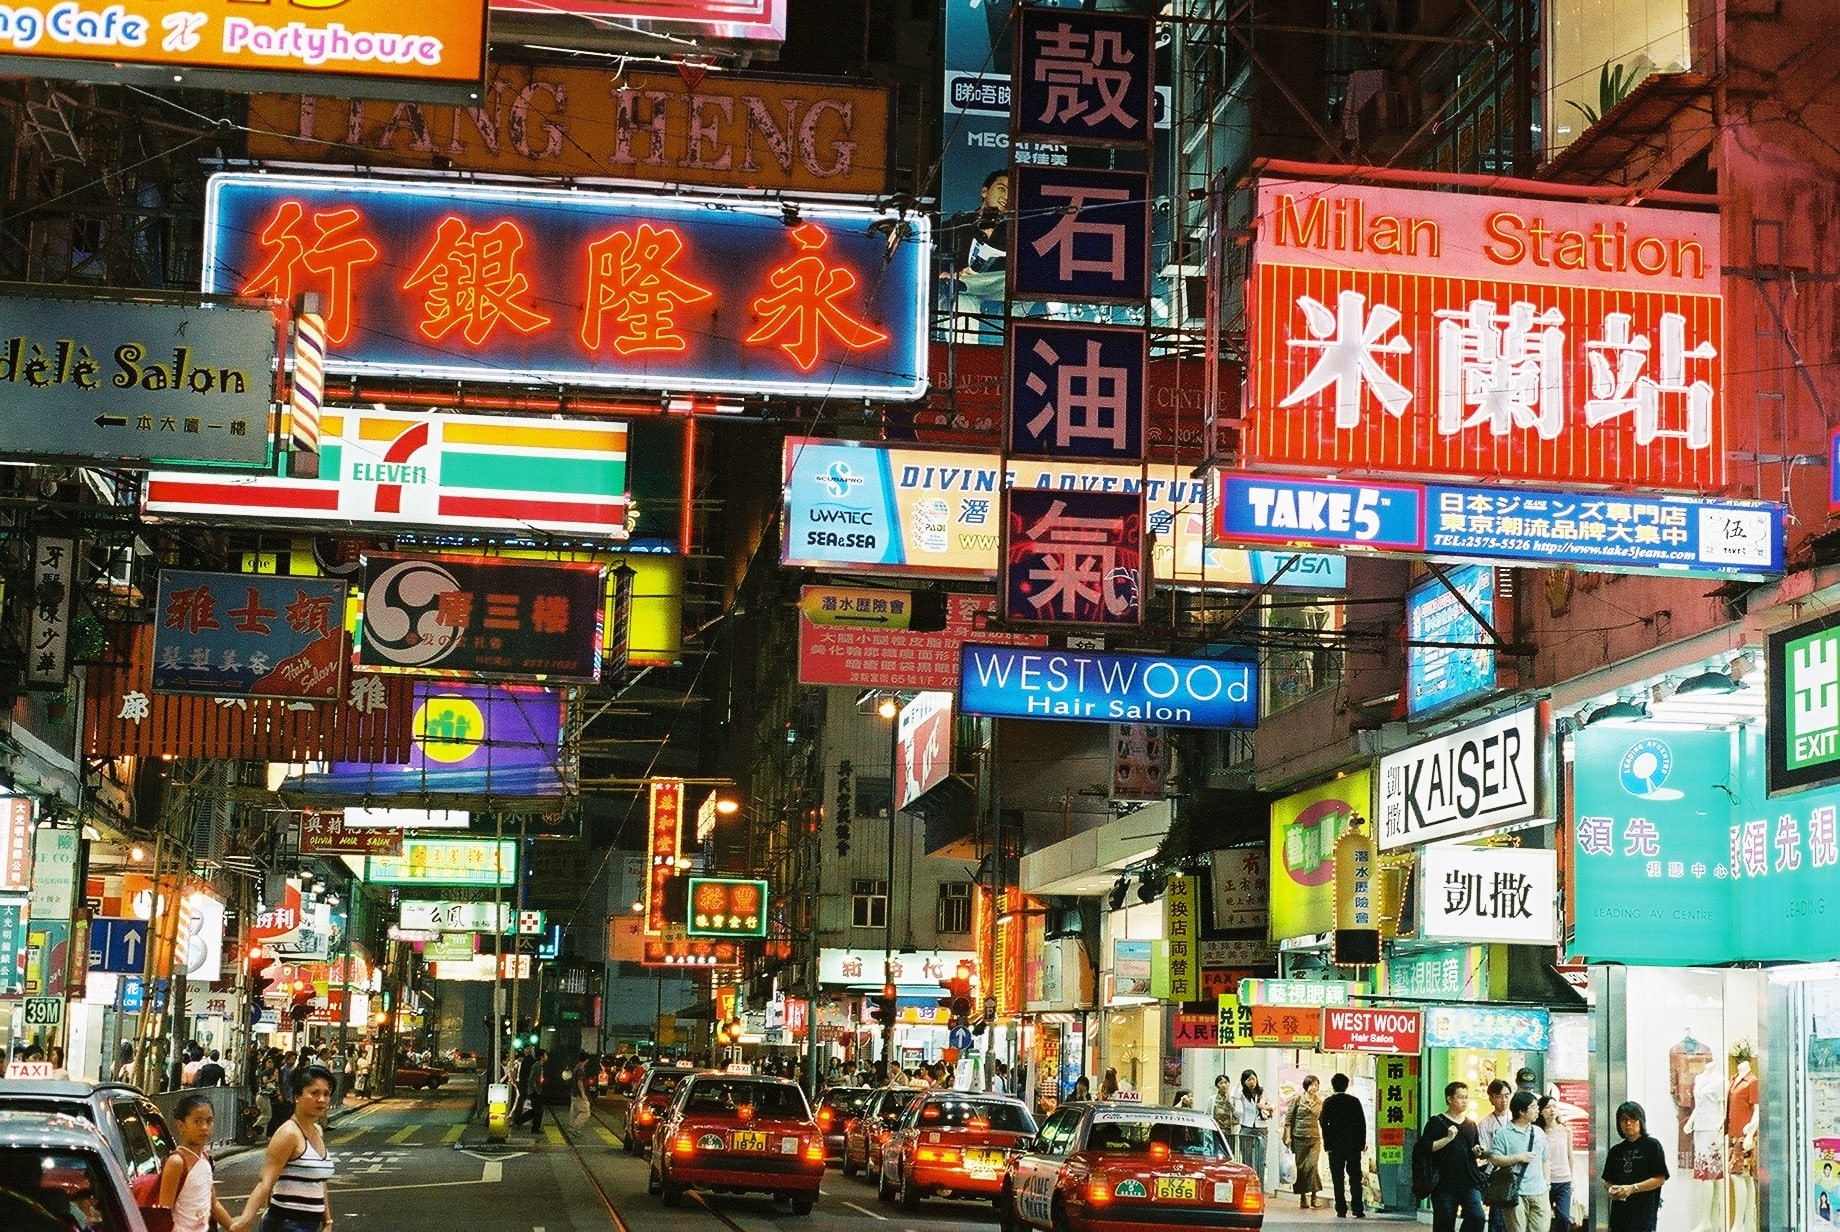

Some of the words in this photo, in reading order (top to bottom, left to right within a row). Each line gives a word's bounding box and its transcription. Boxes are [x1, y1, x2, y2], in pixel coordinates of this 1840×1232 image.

[50, 8, 142, 41] Cafe
[228, 22, 437, 61] Partyhouse
[611, 90, 856, 178] HENG
[1276, 193, 1441, 258] Milan
[1483, 211, 1705, 279] Station
[112, 342, 246, 395] Salon
[1279, 289, 1718, 451] 米蘭站
[815, 475, 864, 484] SCUBAPRO
[810, 509, 873, 525] UWATEC
[1440, 512, 1688, 547] 東京潮流品牌大集中
[1273, 555, 1331, 575] TUSA
[281, 656, 312, 682] Hair
[300, 660, 338, 694] Salon
[1793, 638, 1838, 736] 出
[1027, 695, 1096, 717] Hair
[1109, 700, 1192, 722] Salon
[1795, 730, 1839, 762] EXIT
[1403, 726, 1527, 834] KAISER
[1386, 765, 1401, 839] 凱撒
[309, 835, 333, 846] OLIVIA
[338, 837, 358, 846] HAIR
[366, 837, 390, 847] SALON
[1577, 817, 1660, 856] 領先
[1443, 869, 1534, 919] 凱撒
[1594, 906, 1641, 920] LEADING
[1650, 909, 1664, 919] AV
[1672, 909, 1714, 921] CENTRE
[1204, 974, 1231, 984] FAX
[27, 1003, 59, 1023] 39M
[1261, 1014, 1300, 1035] 永發
[1331, 1012, 1372, 1032] WEST
[1351, 1033, 1370, 1043] Hair
[1370, 1033, 1394, 1044] Salon
[11, 1065, 50, 1076] TAXI
[1118, 1091, 1139, 1100] TAXI
[1160, 1186, 1193, 1198] 6196
[1168, 1177, 1186, 1188] KZ
